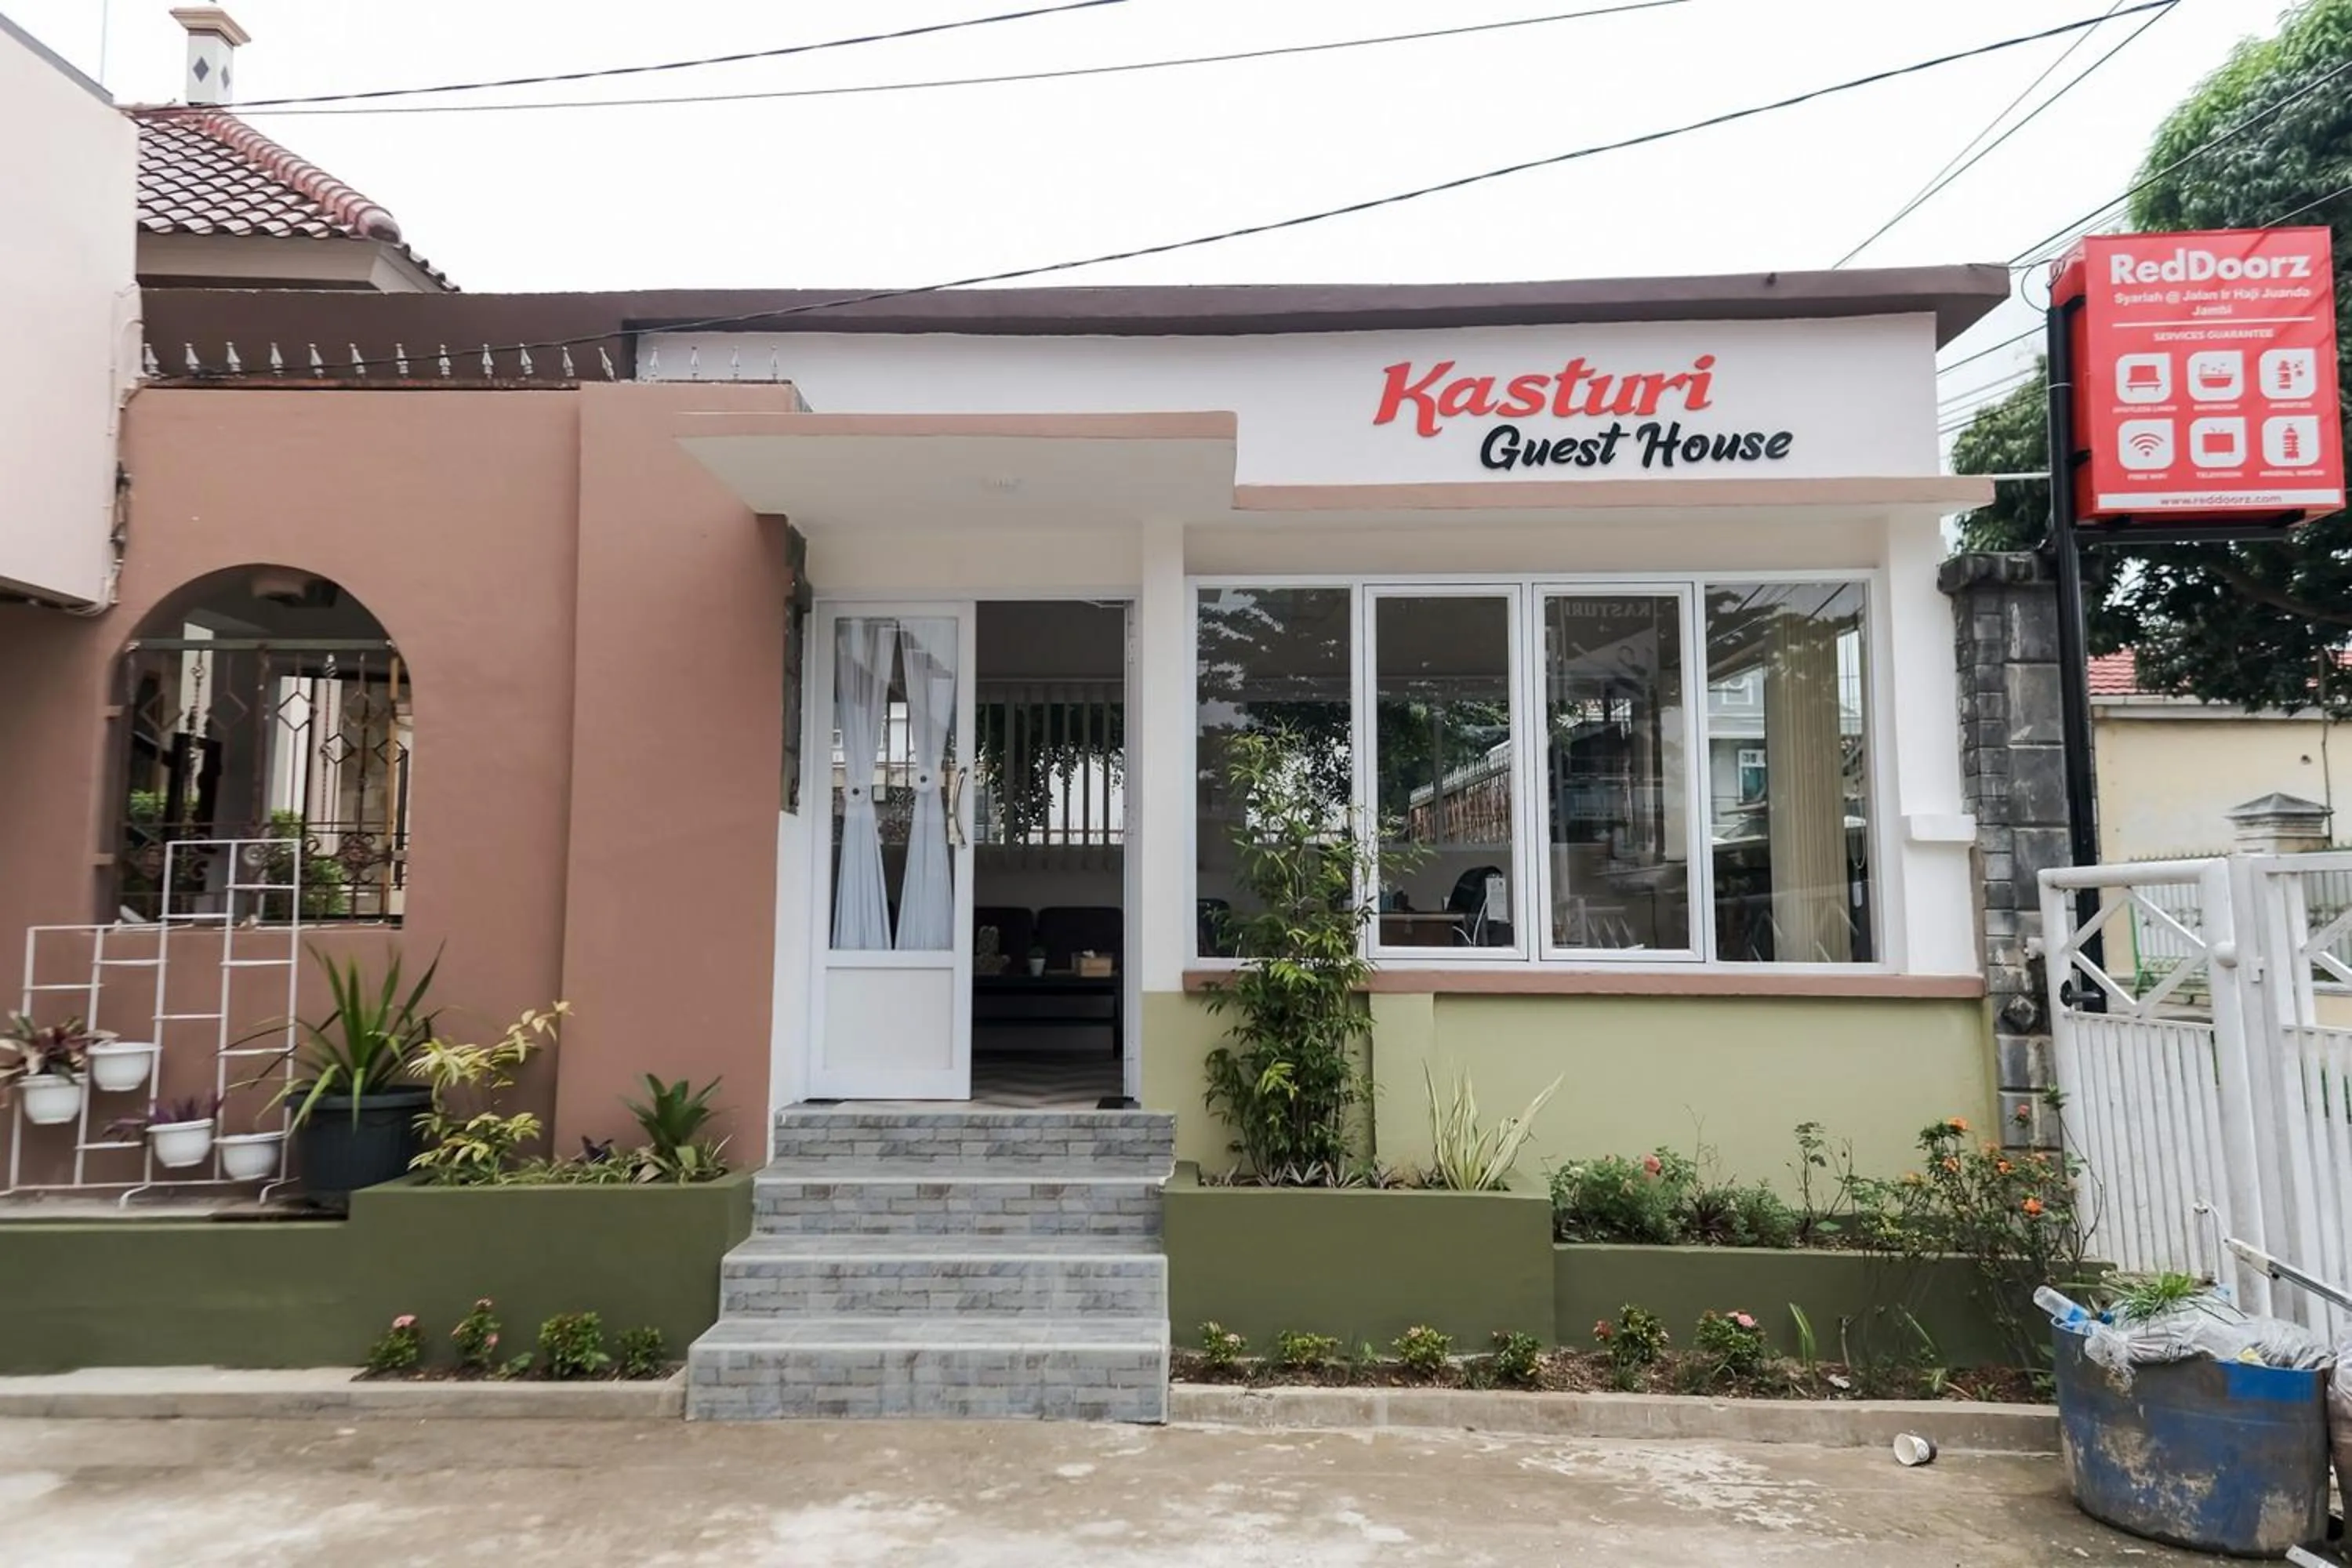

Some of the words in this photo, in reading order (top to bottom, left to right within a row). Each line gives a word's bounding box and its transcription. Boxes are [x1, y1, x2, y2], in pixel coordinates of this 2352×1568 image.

[2111, 249, 2311, 285] RedDoorz
[2114, 292, 2162, 305] Syariah
[2183, 289, 2218, 301] Jalan
[2263, 286, 2311, 299] Juanda
[1374, 354, 1716, 437] Kasturi
[1480, 422, 1630, 471] Guest
[1635, 420, 1793, 469] House
